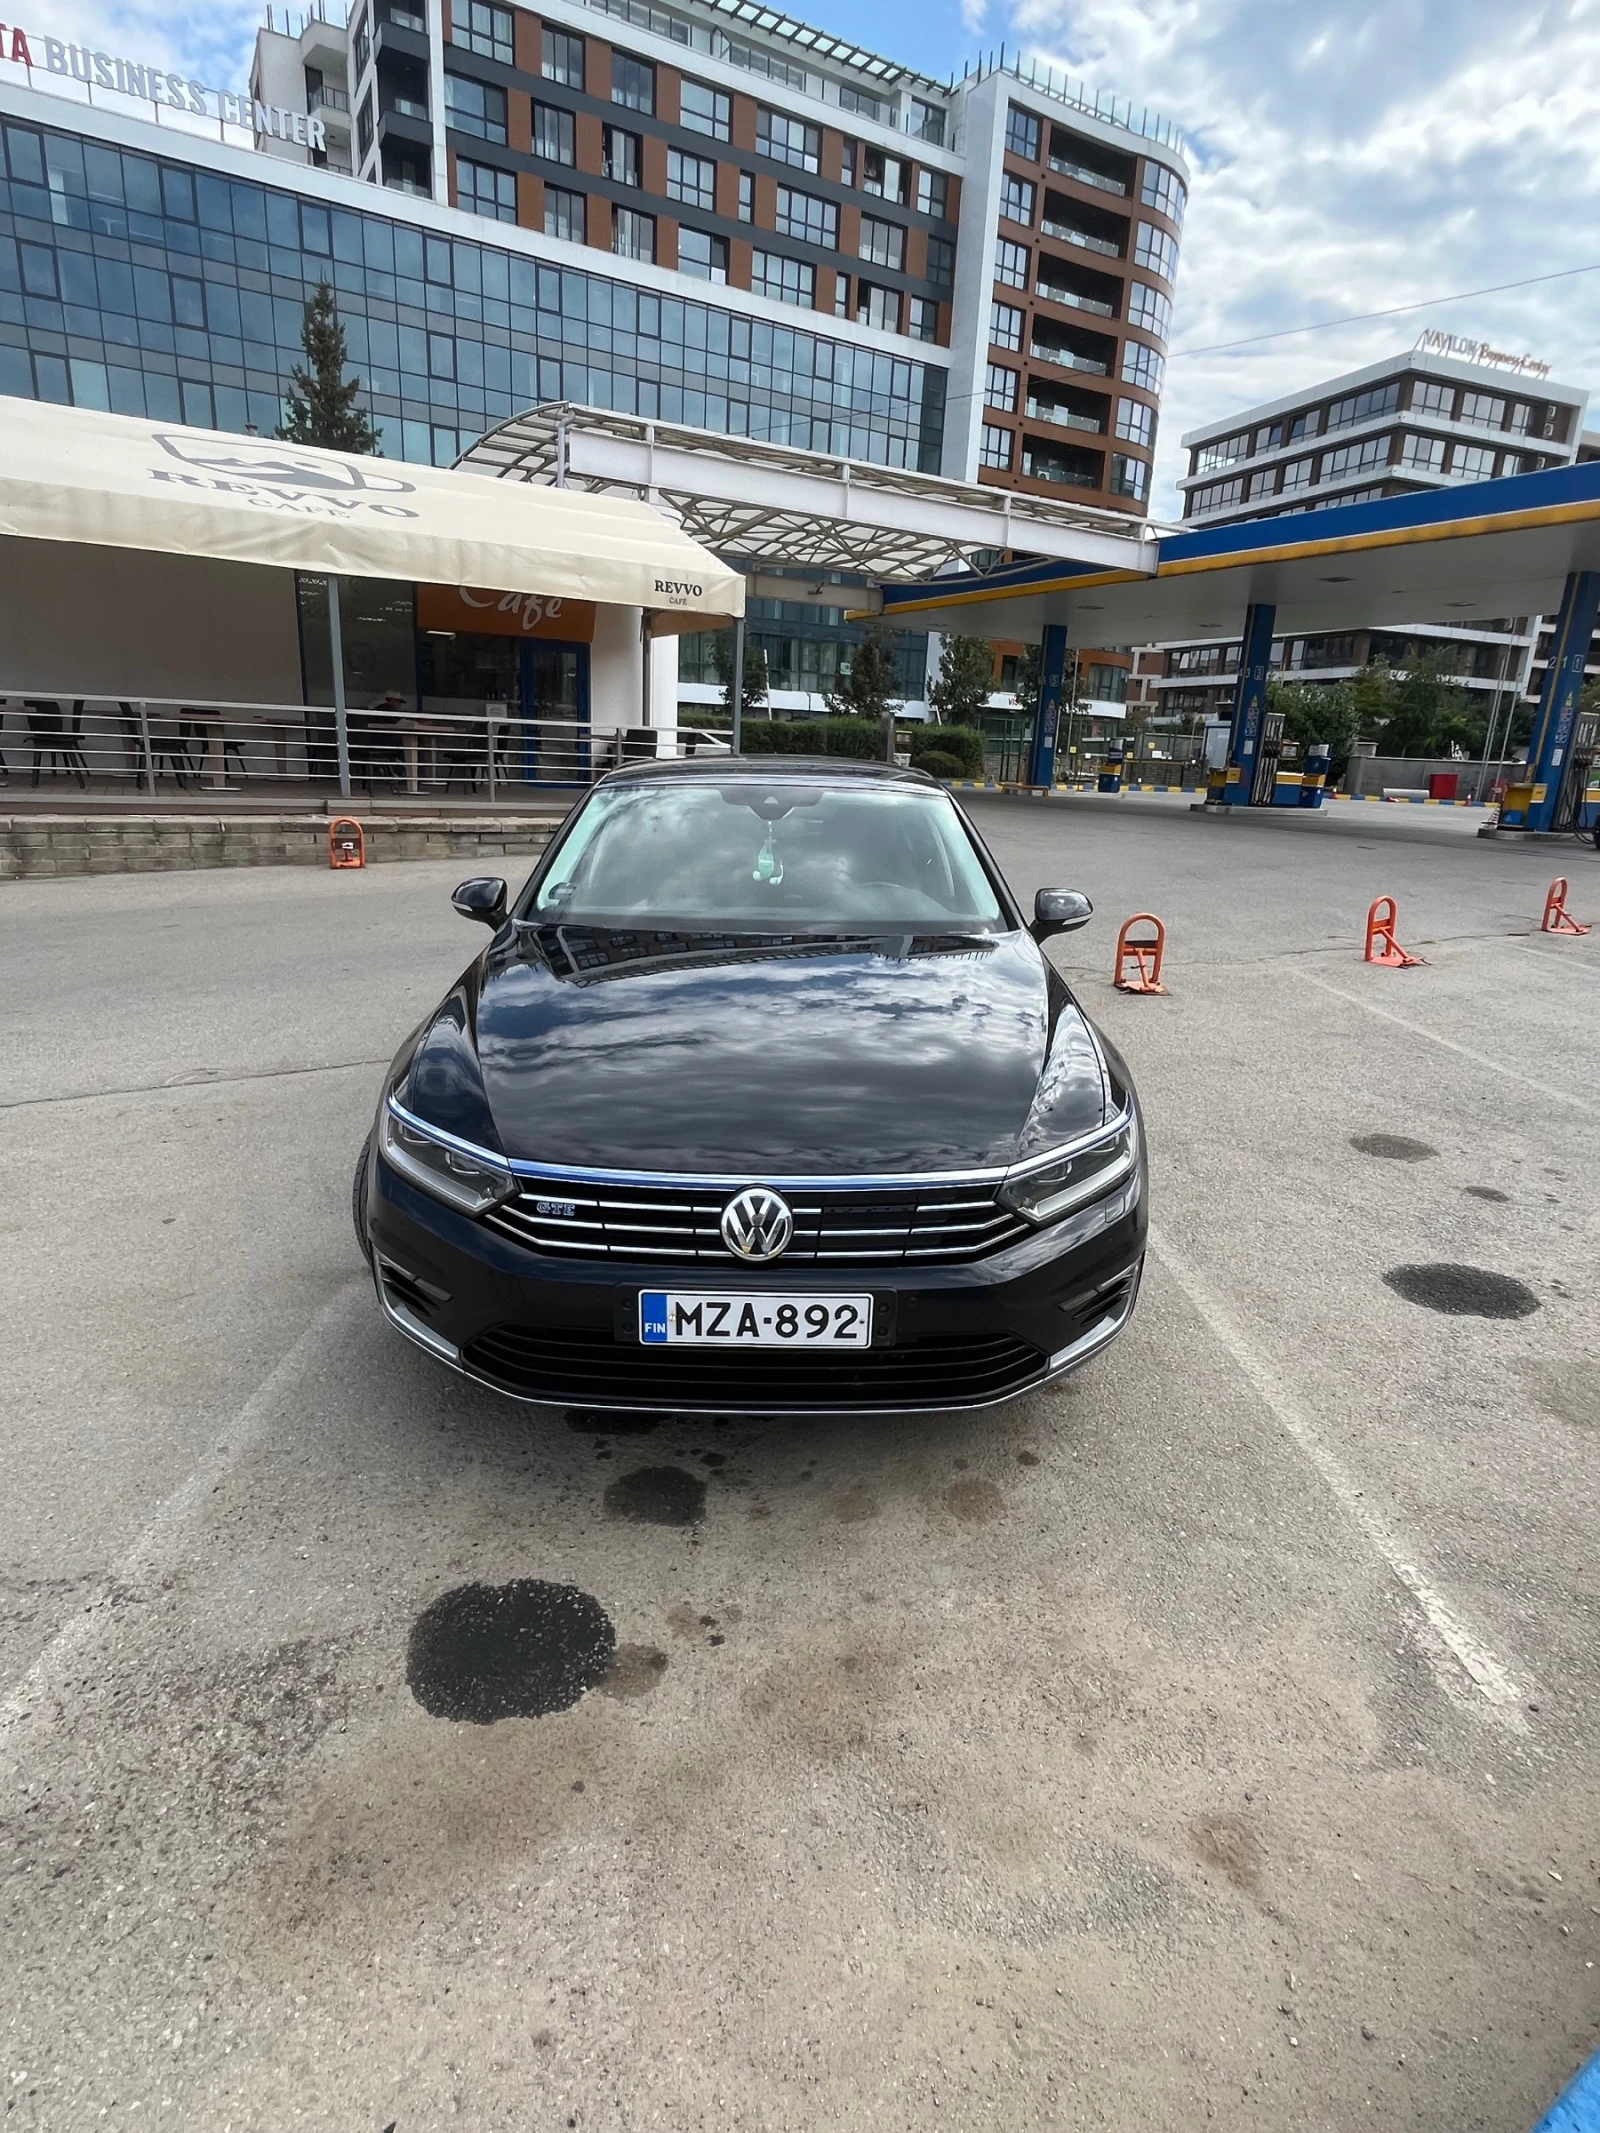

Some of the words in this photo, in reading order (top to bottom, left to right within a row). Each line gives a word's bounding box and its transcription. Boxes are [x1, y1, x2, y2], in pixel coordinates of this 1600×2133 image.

[44, 35, 208, 117] BUSINESS
[218, 88, 327, 152] CENTER
[147, 468, 420, 518] REVVO
[654, 579, 703, 597] REVVO
[1548, 656, 1557, 669] 2
[1562, 656, 1568, 669] 1
[536, 1201, 576, 1217] GTE
[644, 1322, 666, 1335] FIN
[675, 1301, 859, 1339] MZA-892
